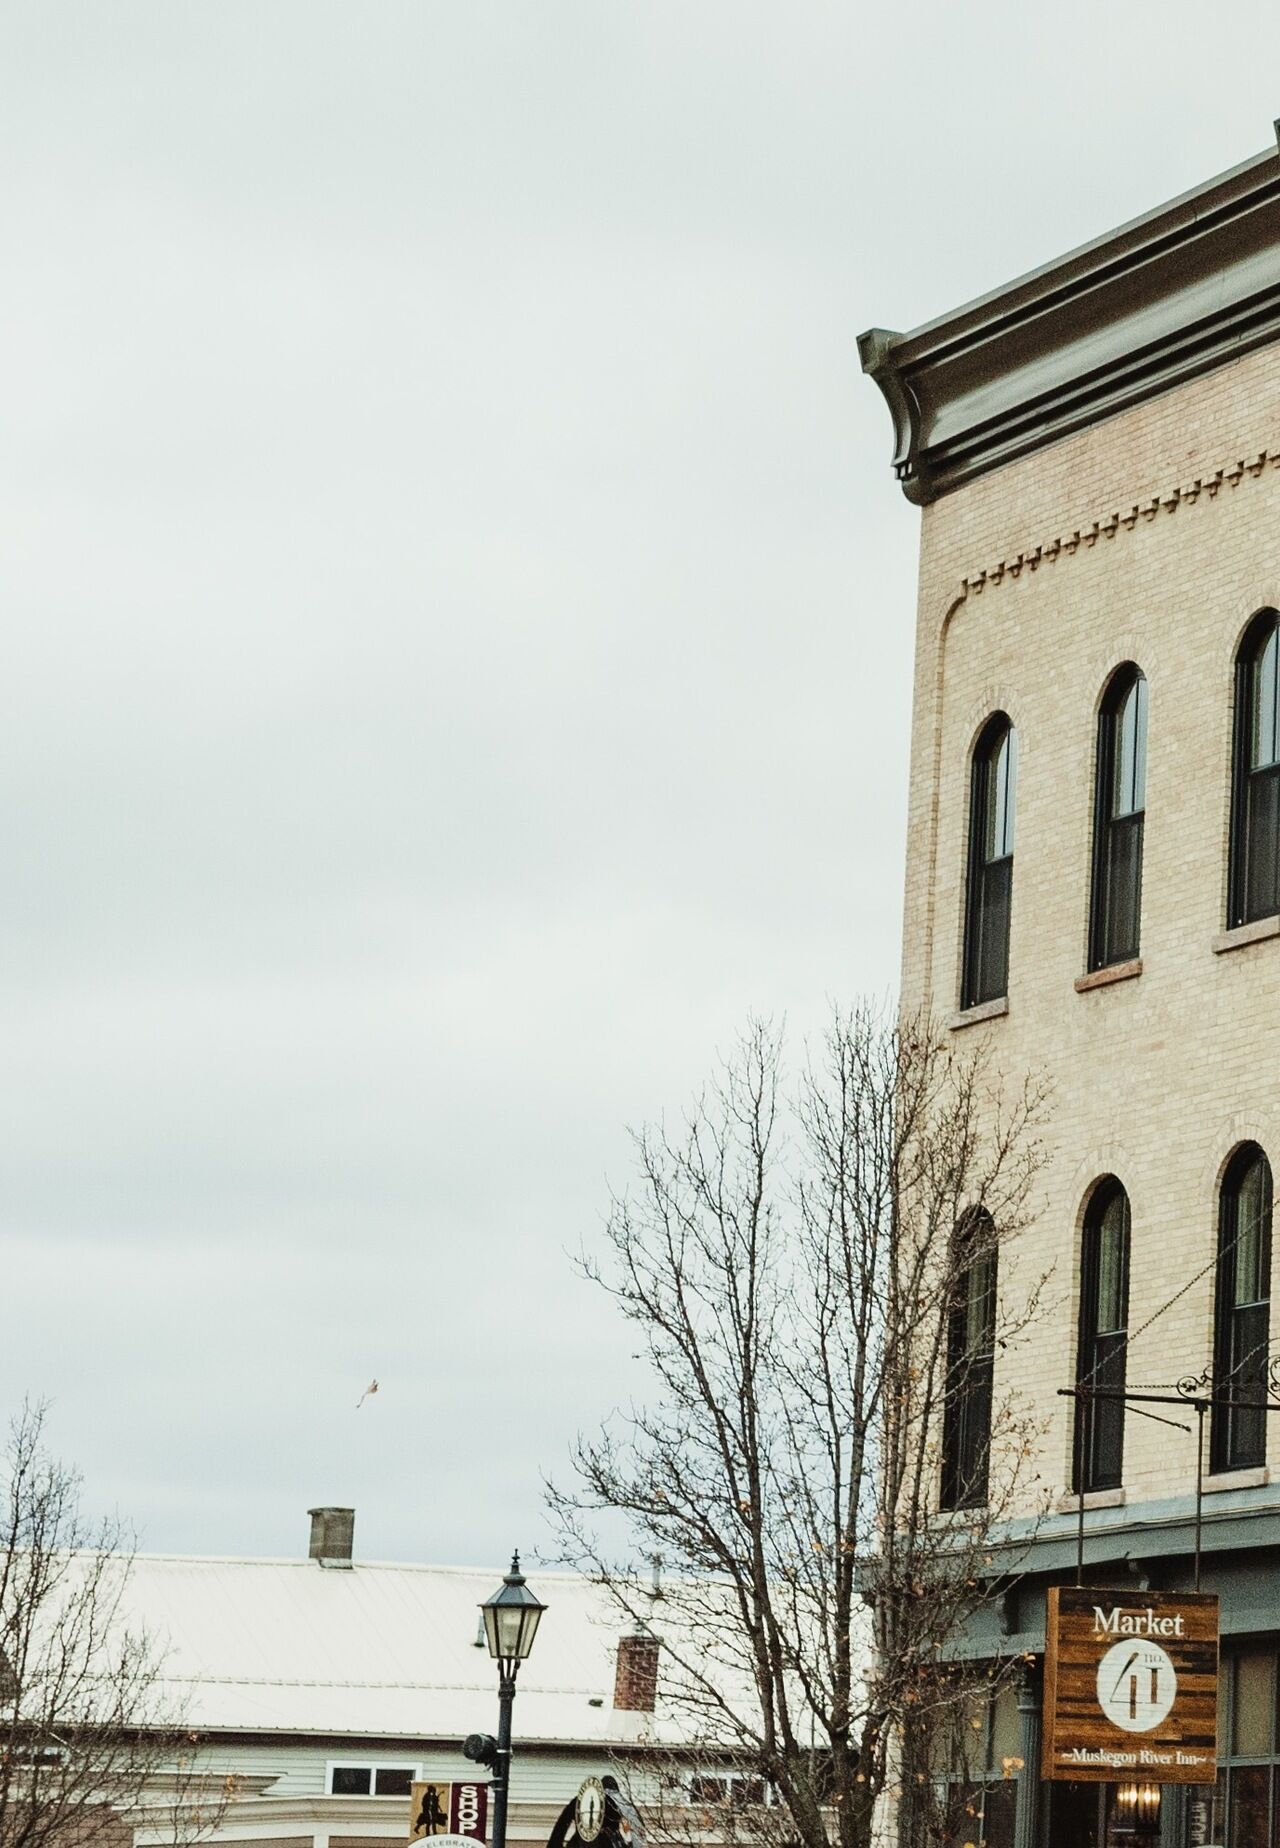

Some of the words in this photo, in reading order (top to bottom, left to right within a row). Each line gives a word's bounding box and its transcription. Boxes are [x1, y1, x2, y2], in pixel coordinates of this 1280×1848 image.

[1093, 1606, 1185, 1636] Market
[1110, 1652, 1163, 1719] 41
[1140, 1751, 1172, 1764] River
[458, 1785, 479, 1834] SHOP
